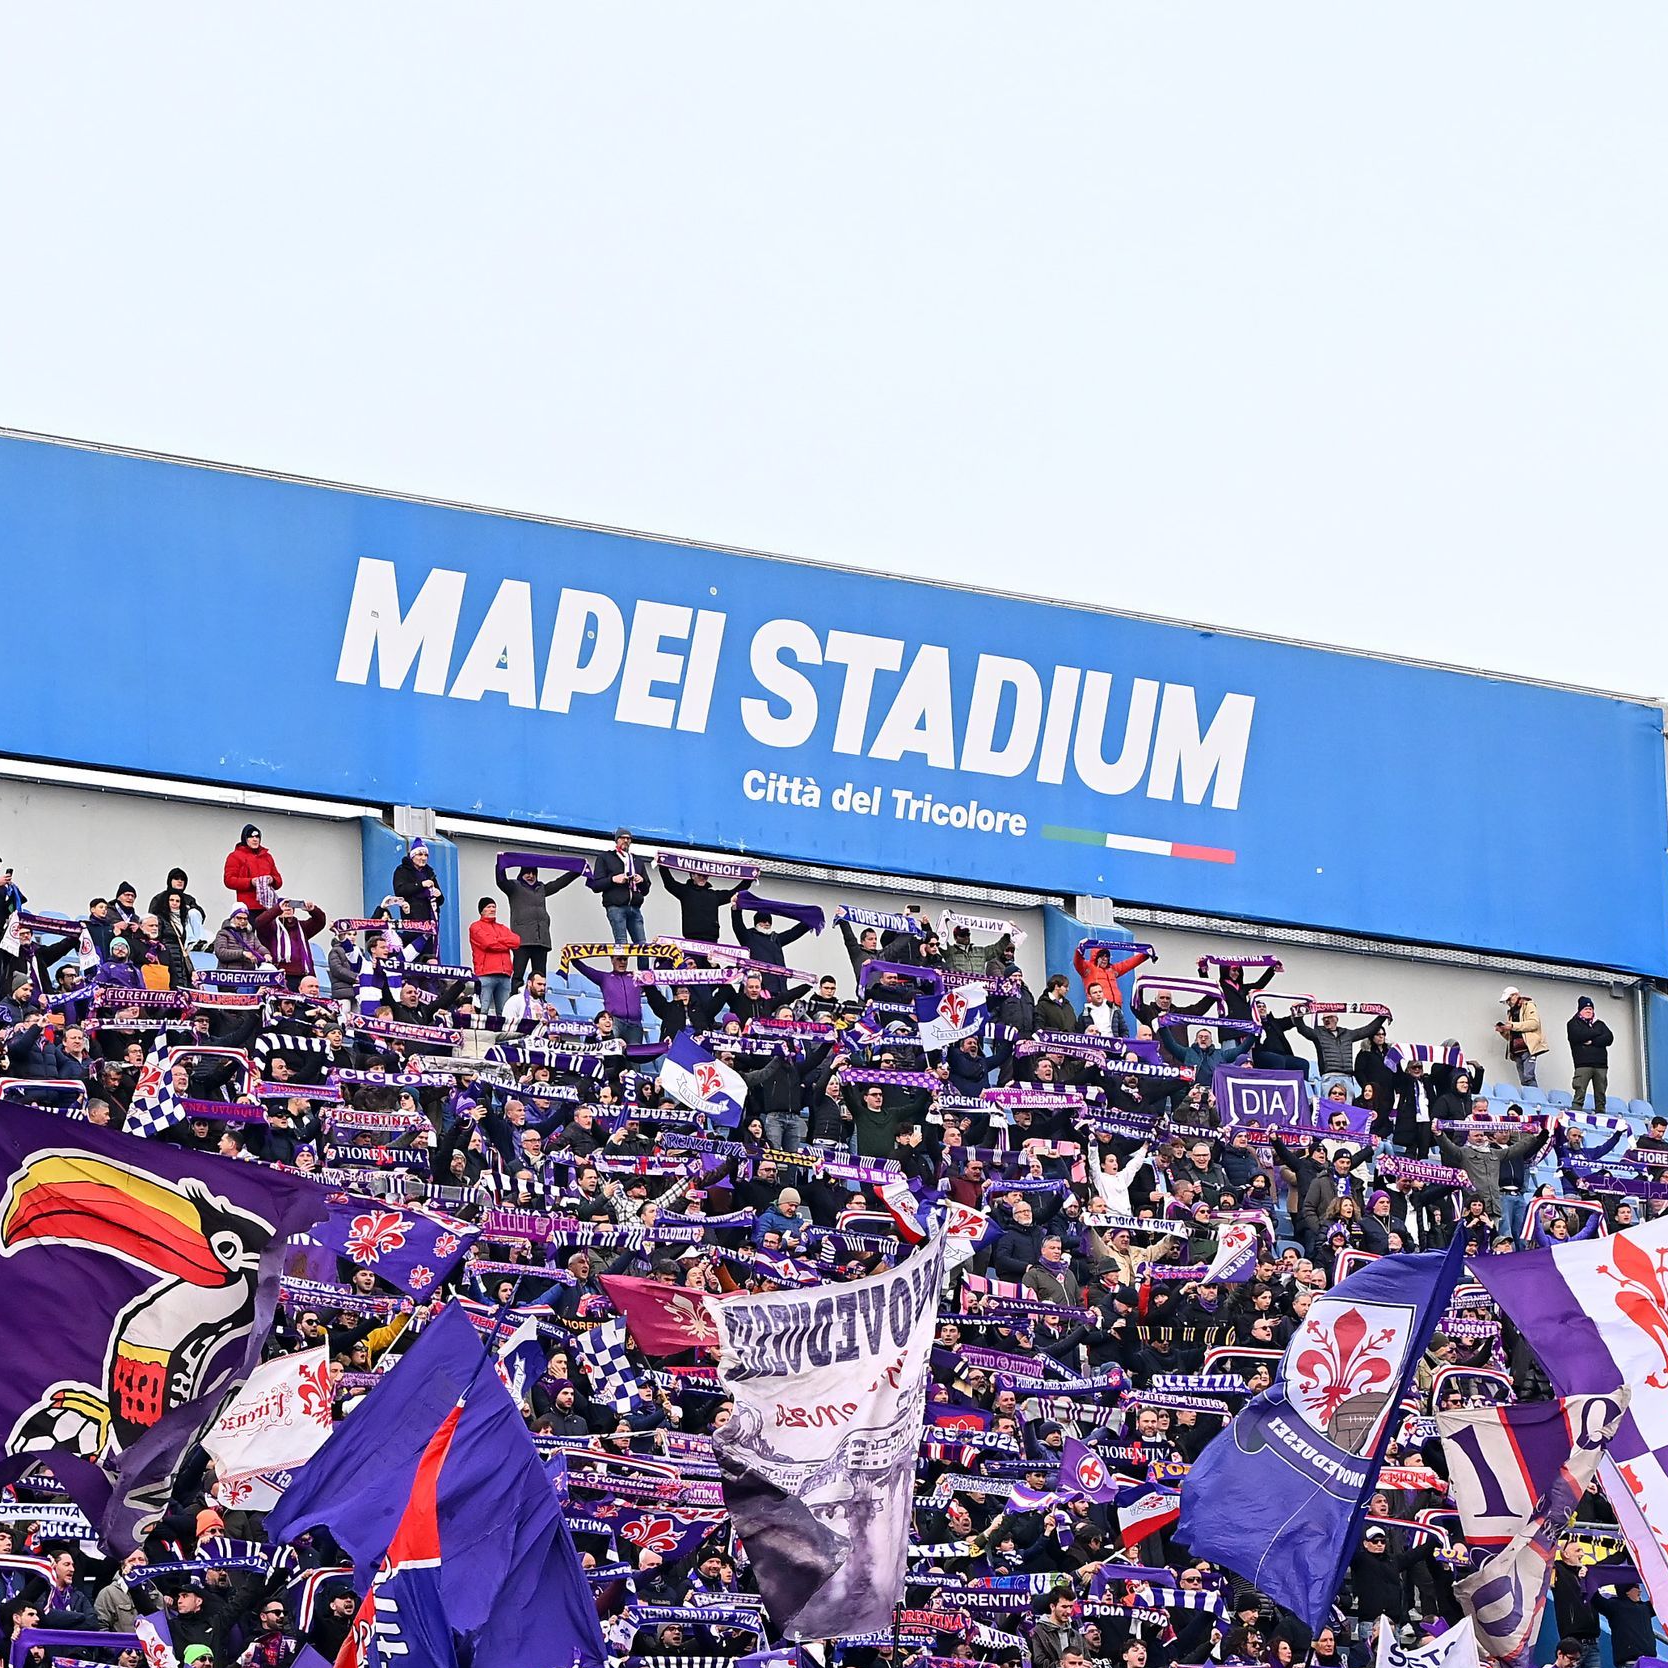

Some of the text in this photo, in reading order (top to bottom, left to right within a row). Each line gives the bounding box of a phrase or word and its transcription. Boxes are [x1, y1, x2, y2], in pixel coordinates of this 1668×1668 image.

[336, 556, 1255, 811] MAPEI STADIUM
[743, 769, 1028, 837] Città del Tricolore
[1242, 1078, 1285, 1114] DIA
[943, 1591, 1031, 1608] FIORENTINA
